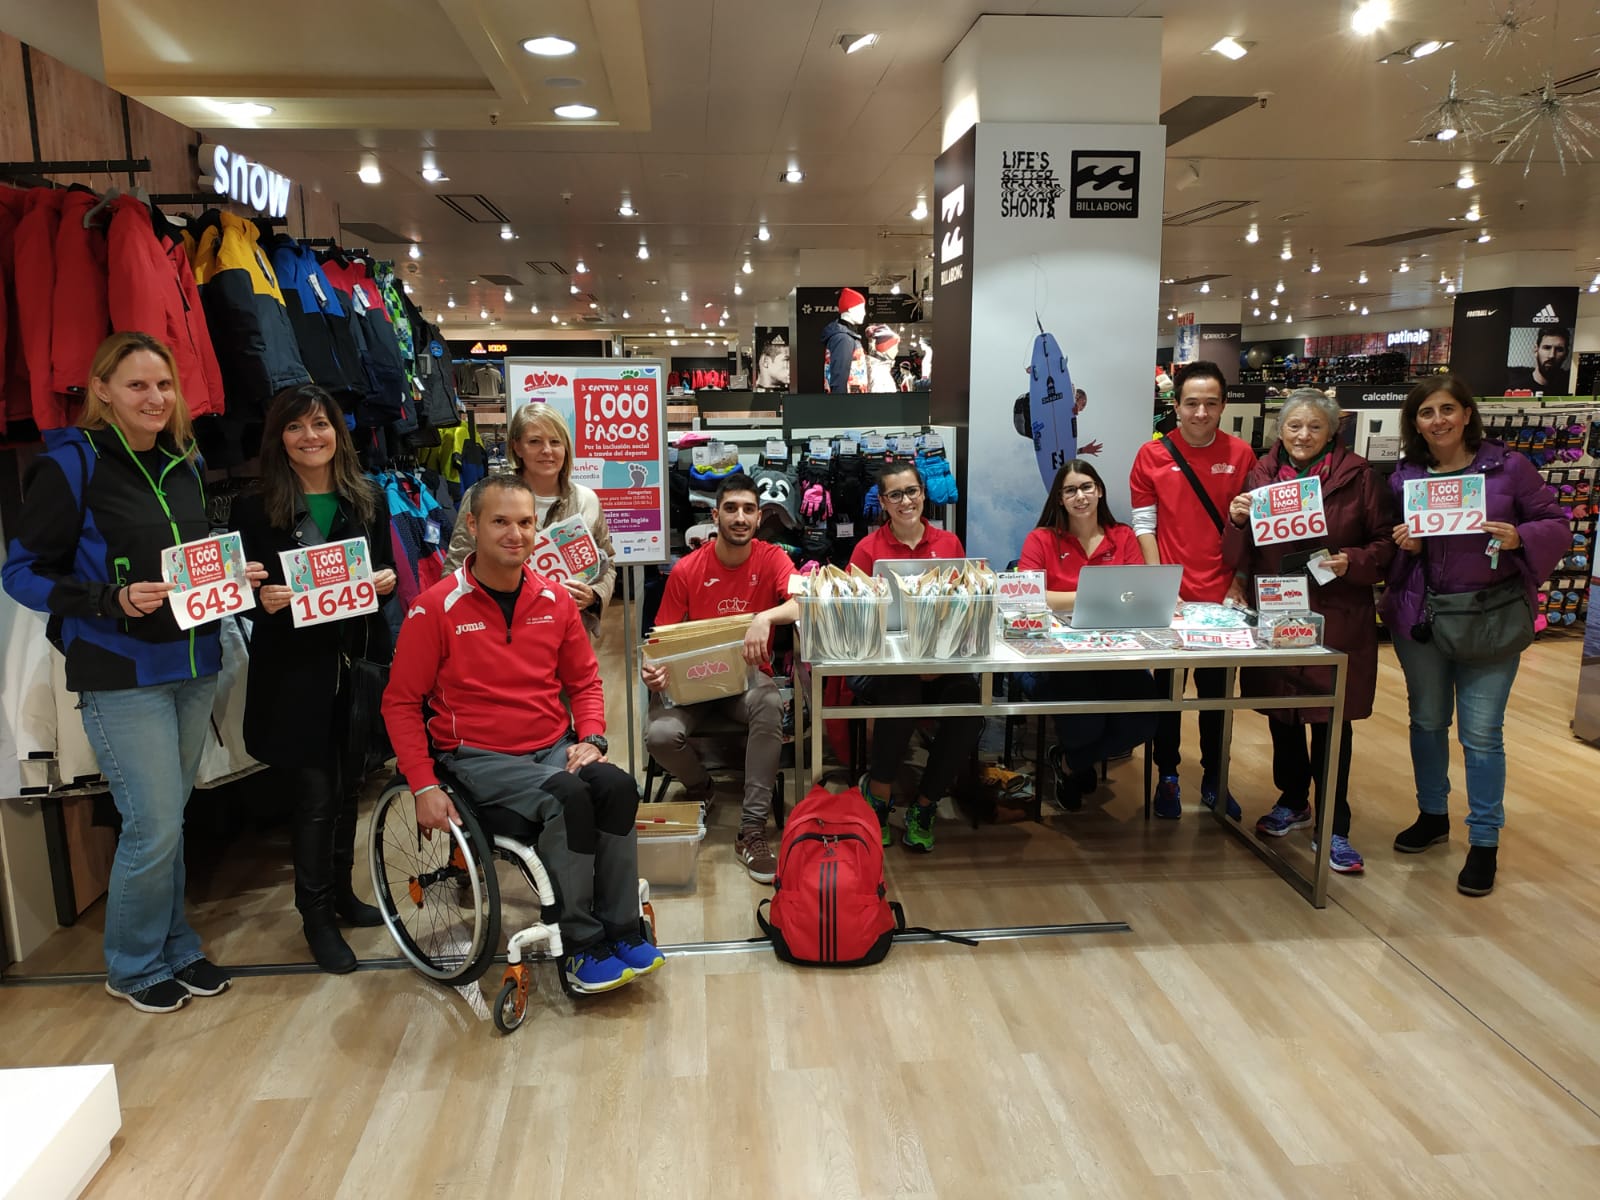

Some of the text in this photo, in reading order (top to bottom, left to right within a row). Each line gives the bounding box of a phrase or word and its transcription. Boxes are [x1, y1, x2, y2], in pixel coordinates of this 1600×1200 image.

[1002, 150, 1050, 169] LIFE'S
[213, 144, 291, 218] snow
[1075, 201, 1133, 212] BILLABONG
[940, 263, 964, 287] BILLABONG
[1532, 316, 1560, 324] adidas
[1387, 328, 1431, 347] patinaje
[582, 392, 649, 422] 1.000
[584, 422, 649, 442] PASOS
[624, 449, 648, 457] deporte
[1272, 487, 1298, 501] 1.000
[1431, 484, 1459, 496] 1.000
[630, 516, 649, 525] Inglés
[1255, 512, 1325, 542] 2666
[1408, 510, 1484, 534] 1972
[189, 547, 218, 568] 1.000
[312, 551, 343, 570] 1.000
[191, 562, 221, 577] PASOS
[315, 565, 346, 578] PASOS
[186, 582, 243, 621] 643
[296, 581, 375, 621] 1649
